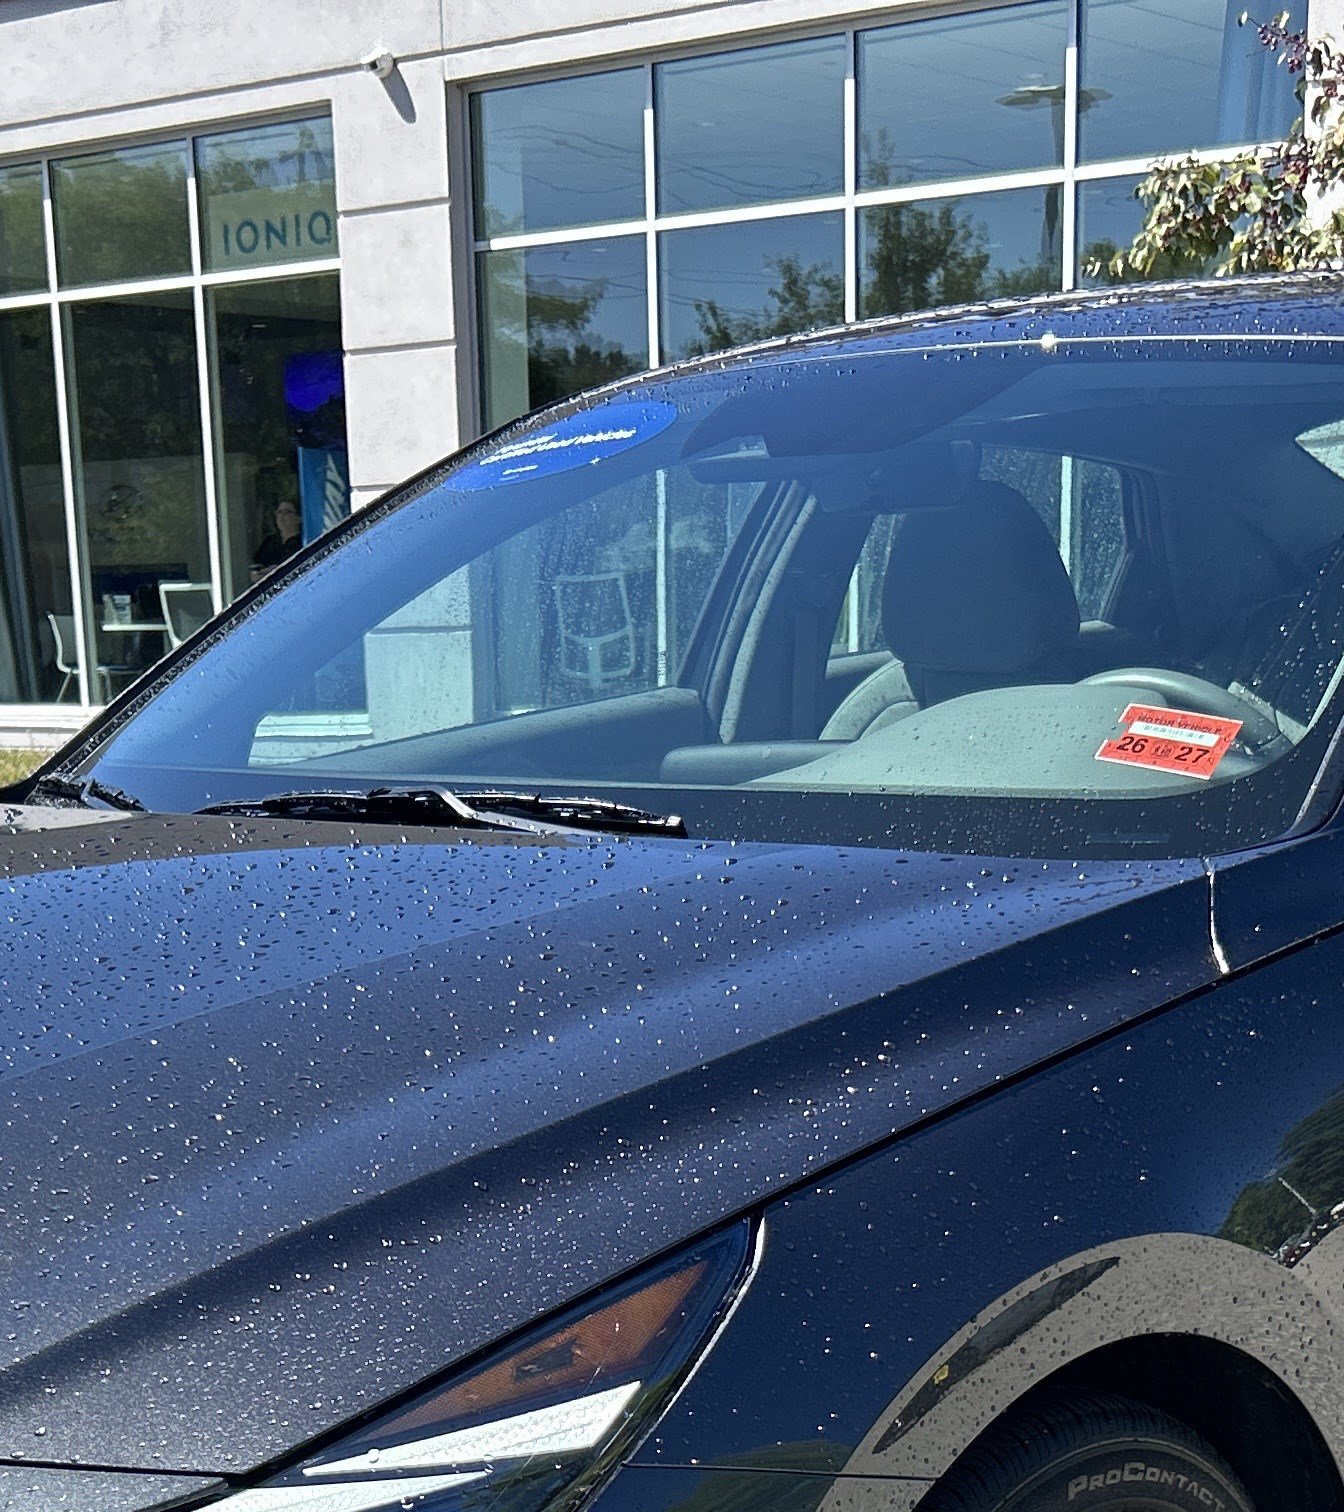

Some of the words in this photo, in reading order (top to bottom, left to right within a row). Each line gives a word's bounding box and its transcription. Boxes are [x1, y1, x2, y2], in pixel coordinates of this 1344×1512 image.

[222, 209, 332, 257] IONIQ
[1116, 736, 1149, 754] 26
[1174, 745, 1211, 764] 27
